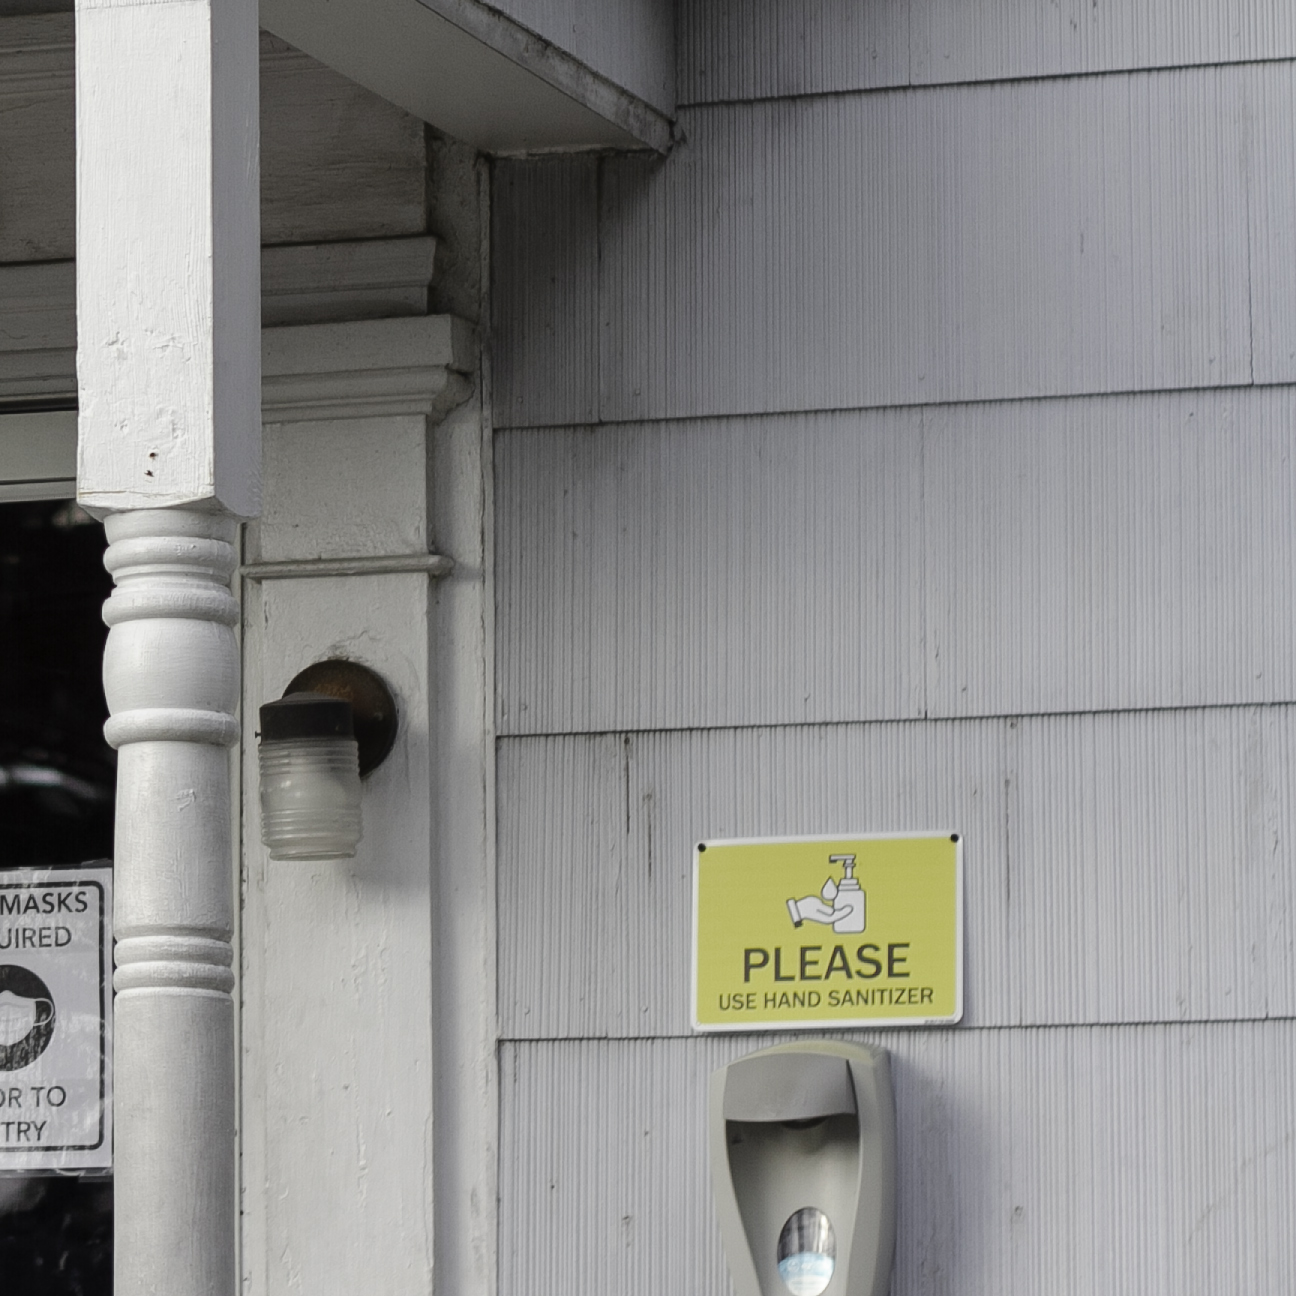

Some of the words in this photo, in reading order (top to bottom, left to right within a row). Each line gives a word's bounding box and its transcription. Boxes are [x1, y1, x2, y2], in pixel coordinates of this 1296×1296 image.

[0, 892, 88, 916] MASKS
[744, 942, 910, 983] PLEASE
[719, 993, 756, 1011] USE
[764, 990, 821, 1009] HAND
[828, 987, 934, 1007] SANITIZER
[31, 1085, 67, 1108] TO
